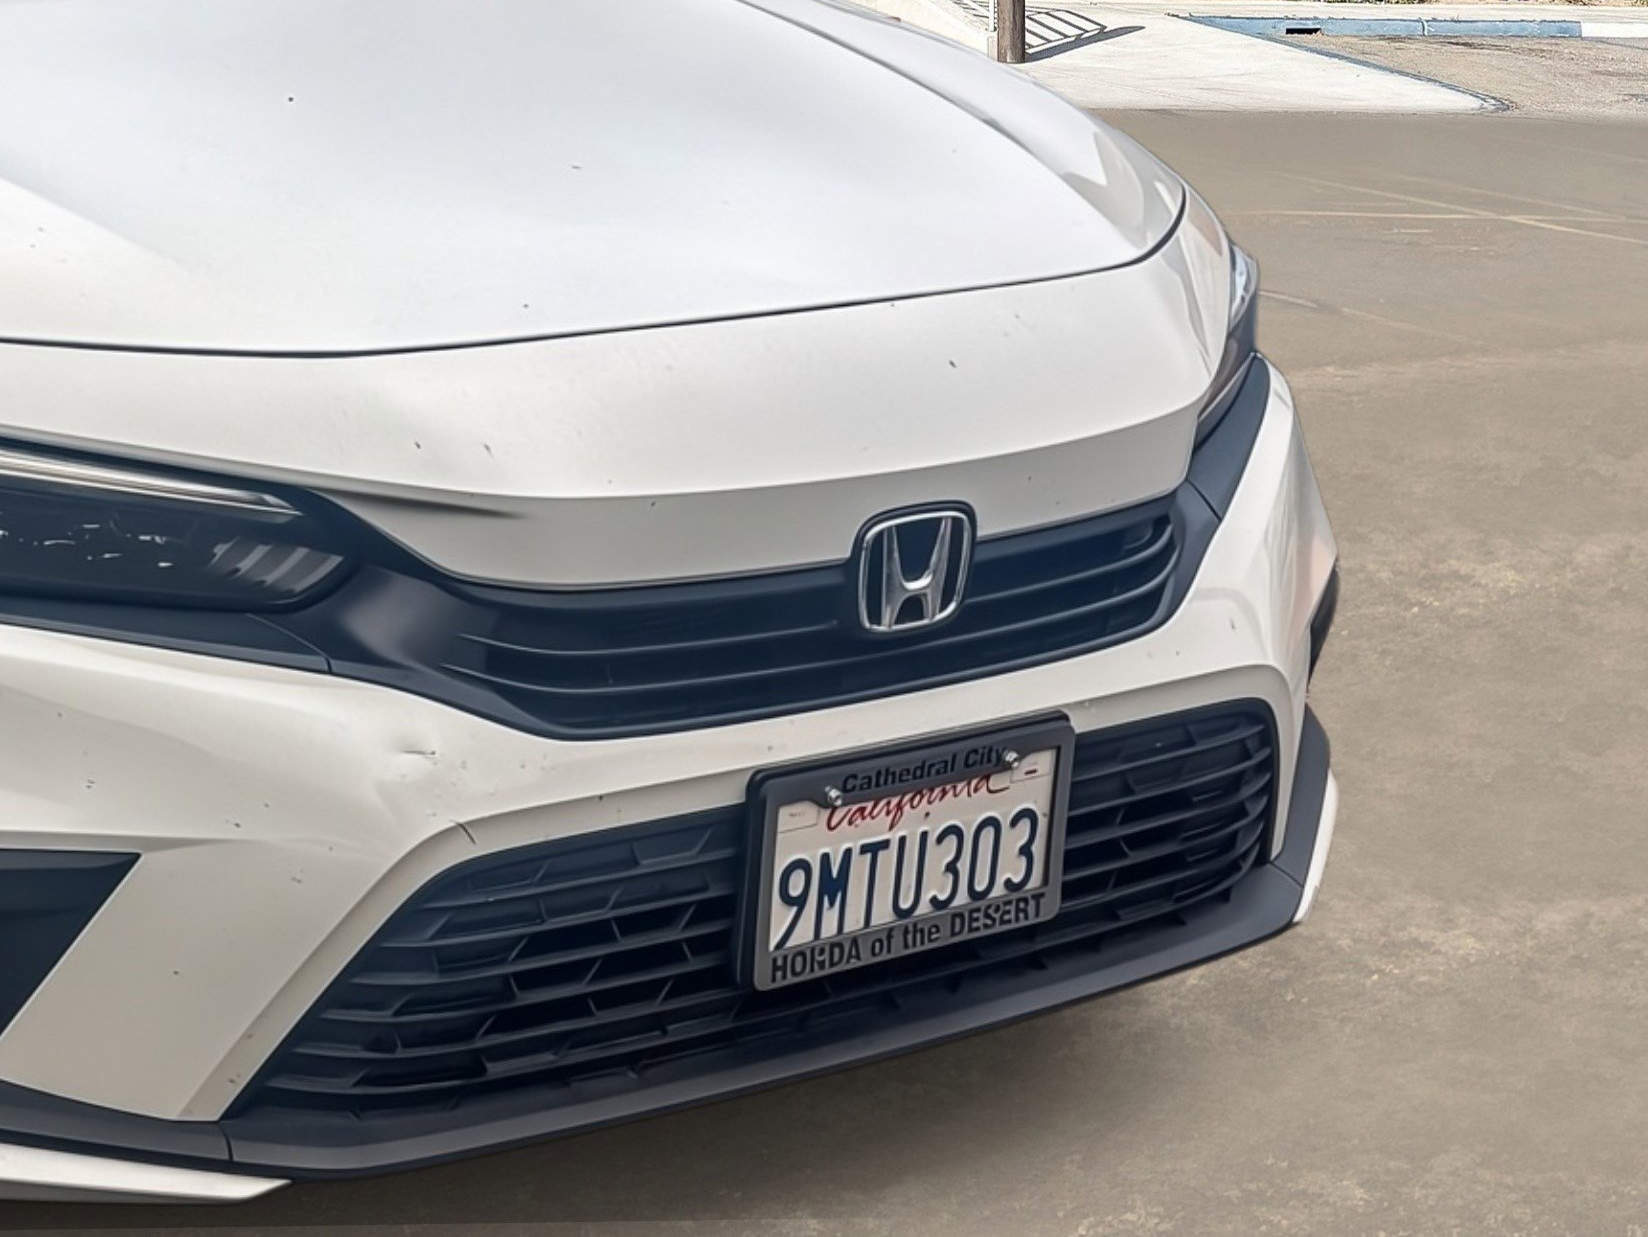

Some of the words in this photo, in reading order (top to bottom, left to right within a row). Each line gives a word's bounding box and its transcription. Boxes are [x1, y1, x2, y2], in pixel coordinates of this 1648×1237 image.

[842, 754, 955, 794] Cathedral
[963, 745, 1005, 770] City
[773, 807, 1039, 950] 9MTU303
[771, 940, 862, 984] HONDA
[871, 934, 896, 957] of
[903, 922, 941, 949] the
[950, 893, 1046, 936] DESERT
